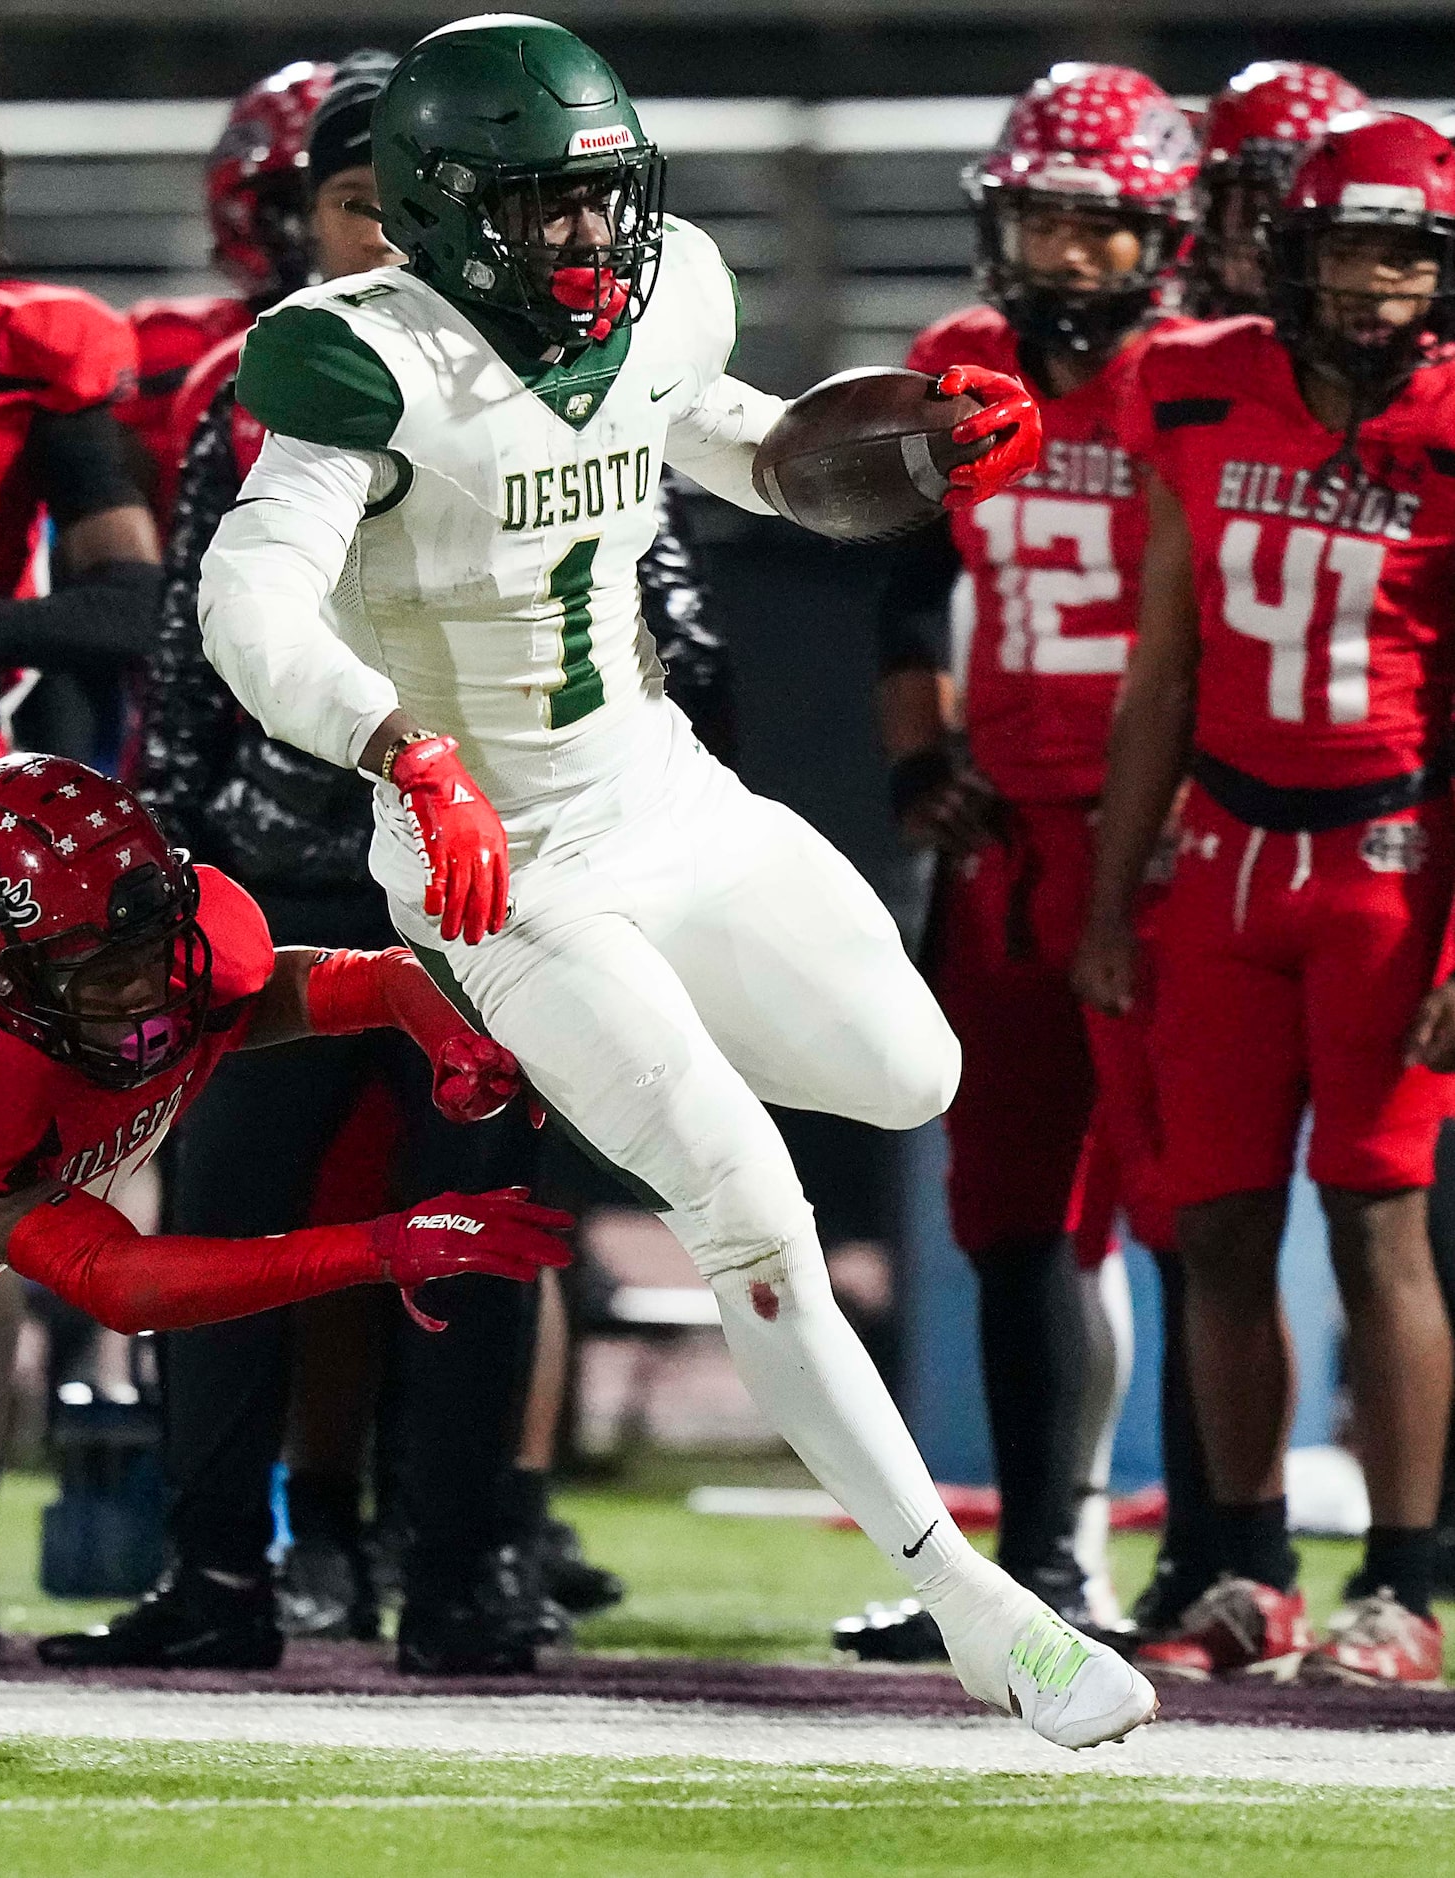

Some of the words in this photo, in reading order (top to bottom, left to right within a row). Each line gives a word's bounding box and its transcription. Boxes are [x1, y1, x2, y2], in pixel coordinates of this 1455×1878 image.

[578, 130, 629, 149] Riddell
[502, 446, 651, 532] DESOTO
[1216, 460, 1422, 541] HILLSIDE
[973, 494, 1128, 675] 12
[1218, 519, 1386, 725] 41
[546, 532, 605, 731] 1
[406, 1213, 486, 1235] PHENOM
